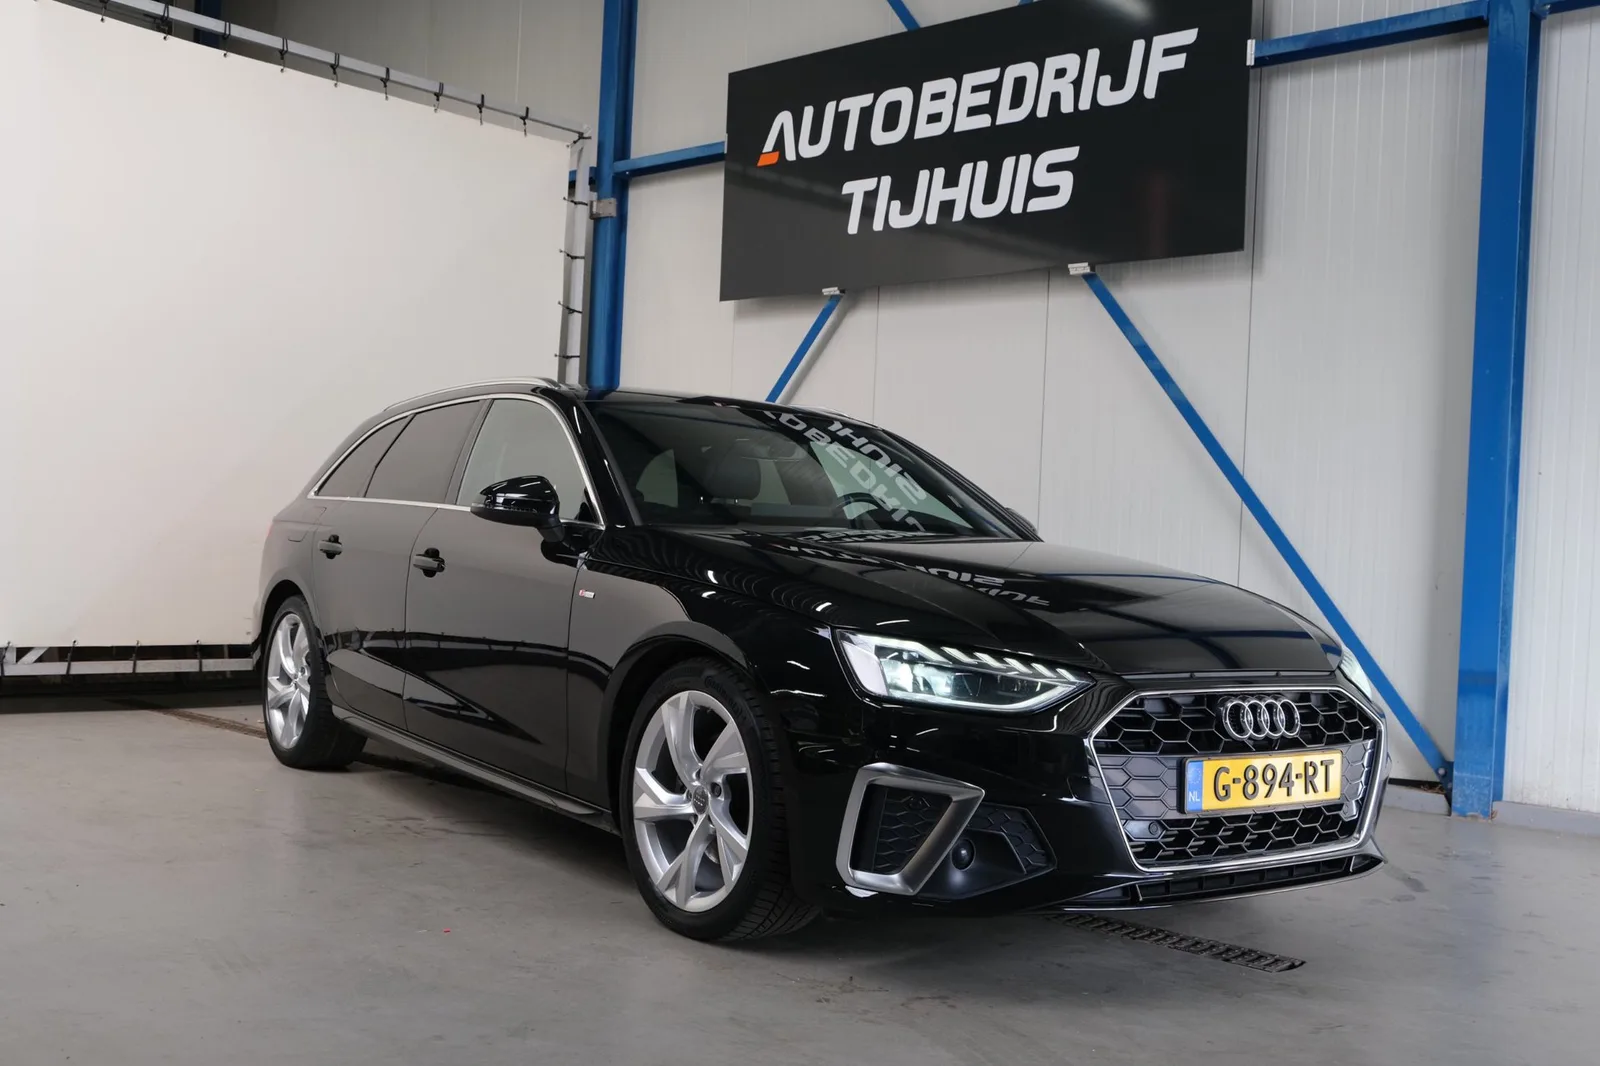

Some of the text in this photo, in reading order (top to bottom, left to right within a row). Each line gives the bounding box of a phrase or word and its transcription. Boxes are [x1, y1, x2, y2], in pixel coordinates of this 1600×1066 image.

[756, 27, 1199, 167] AUTOBEDRIJF
[841, 145, 1080, 235] TIJHUIS
[1188, 790, 1201, 801] NL
[1213, 758, 1335, 802] G-894-RT
